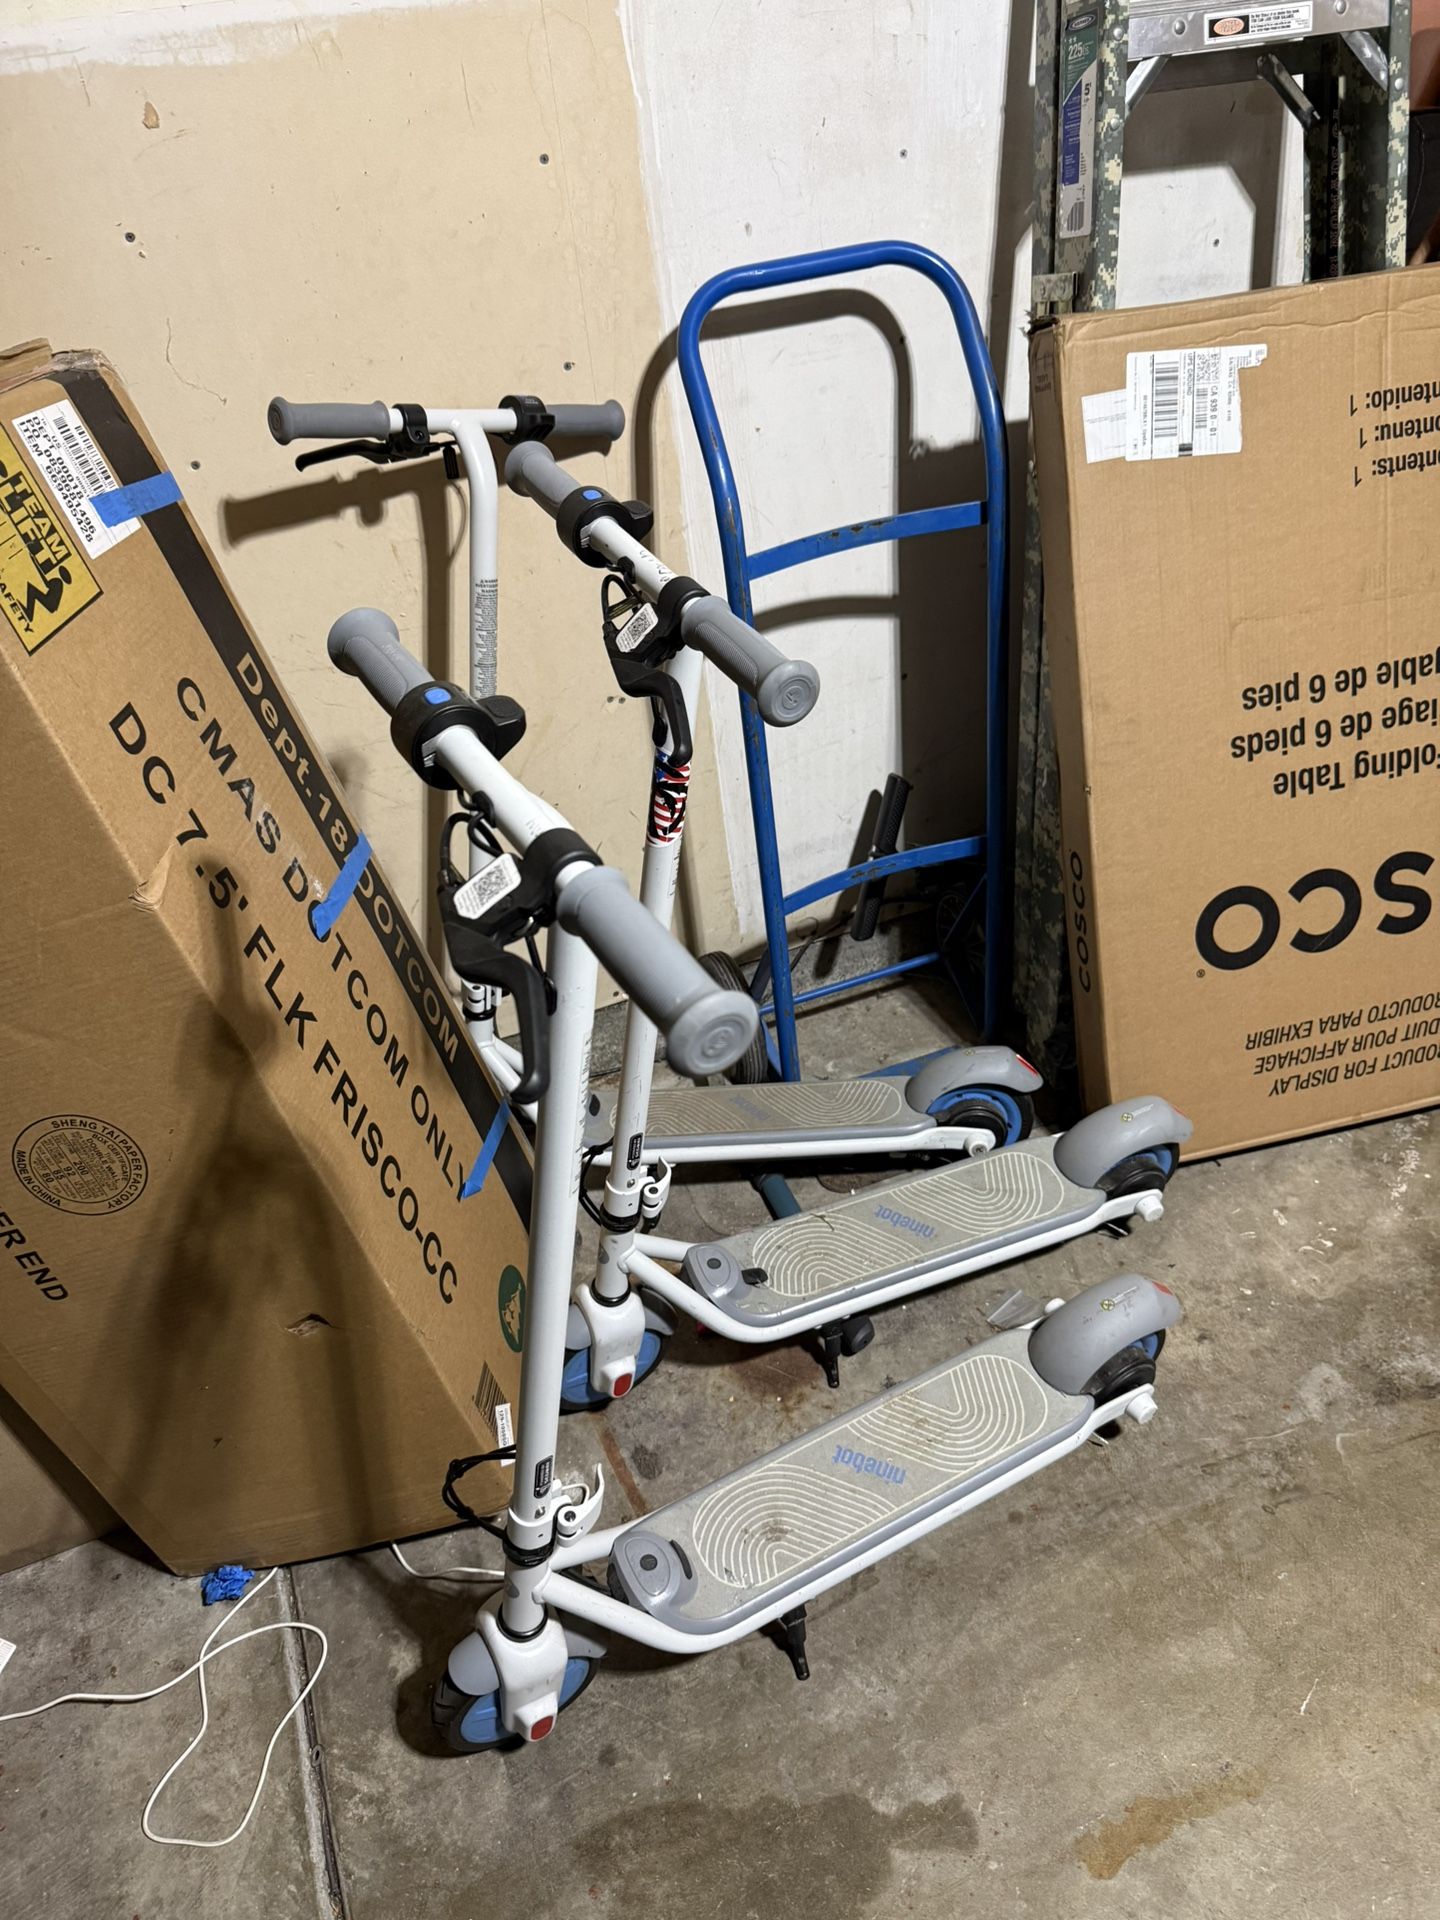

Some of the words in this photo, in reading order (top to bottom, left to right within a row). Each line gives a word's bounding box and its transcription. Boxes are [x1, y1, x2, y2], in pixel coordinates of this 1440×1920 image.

[1068, 42, 1083, 59] 225
[1350, 395, 1358, 416] 1
[1360, 428, 1367, 448] 1
[33, 417, 55, 448] DEPT
[56, 457, 84, 499] 00018
[1372, 450, 1440, 477] ntents:
[20, 422, 43, 456] ITEM
[46, 466, 93, 542] 669495428
[26, 419, 40, 438] PO
[44, 449, 96, 534] 0839681496
[1355, 466, 1362, 487] 1
[0, 482, 57, 564] LIFT
[14, 475, 68, 561] TEAM
[0, 583, 34, 632] AFETY
[1335, 667, 1366, 696] de
[1377, 646, 1440, 688] able
[1242, 672, 1299, 711] pies
[1310, 675, 1325, 703] 6
[1231, 717, 1305, 762] pieds
[1315, 720, 1331, 747] 6
[1341, 712, 1372, 740] de
[178, 678, 280, 854] CMAS
[1355, 744, 1440, 779] olding
[1274, 762, 1345, 798] Table
[1069, 851, 1091, 993] COSCO
[109, 702, 175, 804] DC
[243, 924, 317, 1050] FLK
[313, 1042, 457, 1304] FRISCO-CC
[1246, 1020, 1313, 1050] EXHIBIR
[1320, 1010, 1362, 1034] PARA
[1254, 1038, 1349, 1074] AFFICHAGE
[1352, 1027, 1398, 1052] POUR
[1344, 1057, 1377, 1080] FOR
[1380, 1044, 1440, 1071] ODUCT
[1269, 1066, 1339, 1096] DISPLAY
[52, 1119, 96, 1131] SHENG
[101, 1125, 120, 1141] TAI
[64, 1166, 76, 1176] 92
[73, 1161, 89, 1175] 200
[118, 1138, 142, 1171] PAPER
[17, 1150, 29, 1175] MADE
[23, 1174, 35, 1186] IN
[32, 1185, 60, 1206] CHINA
[108, 1173, 142, 1208] FACTORY
[874, 1205, 936, 1240] ninebot
[0, 1210, 26, 1248] ER
[15, 1252, 68, 1300] END
[832, 1446, 906, 1485] ninebot
